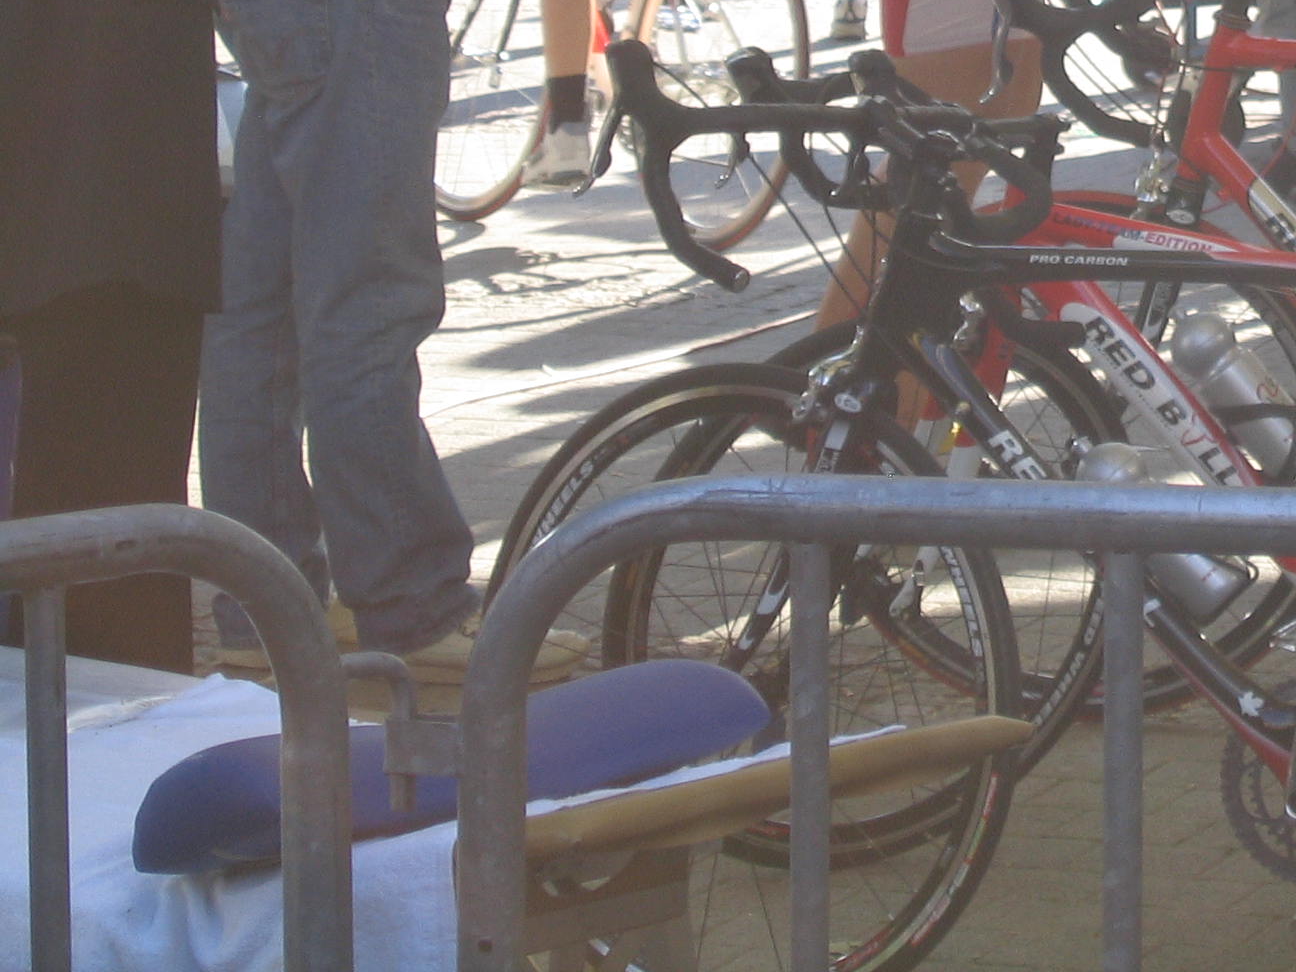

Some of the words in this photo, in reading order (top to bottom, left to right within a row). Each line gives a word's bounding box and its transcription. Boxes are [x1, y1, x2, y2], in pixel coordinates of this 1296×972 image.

[1029, 254, 1060, 265] PRO
[1064, 254, 1129, 267] CARBON
[1086, 317, 1156, 390] RED
